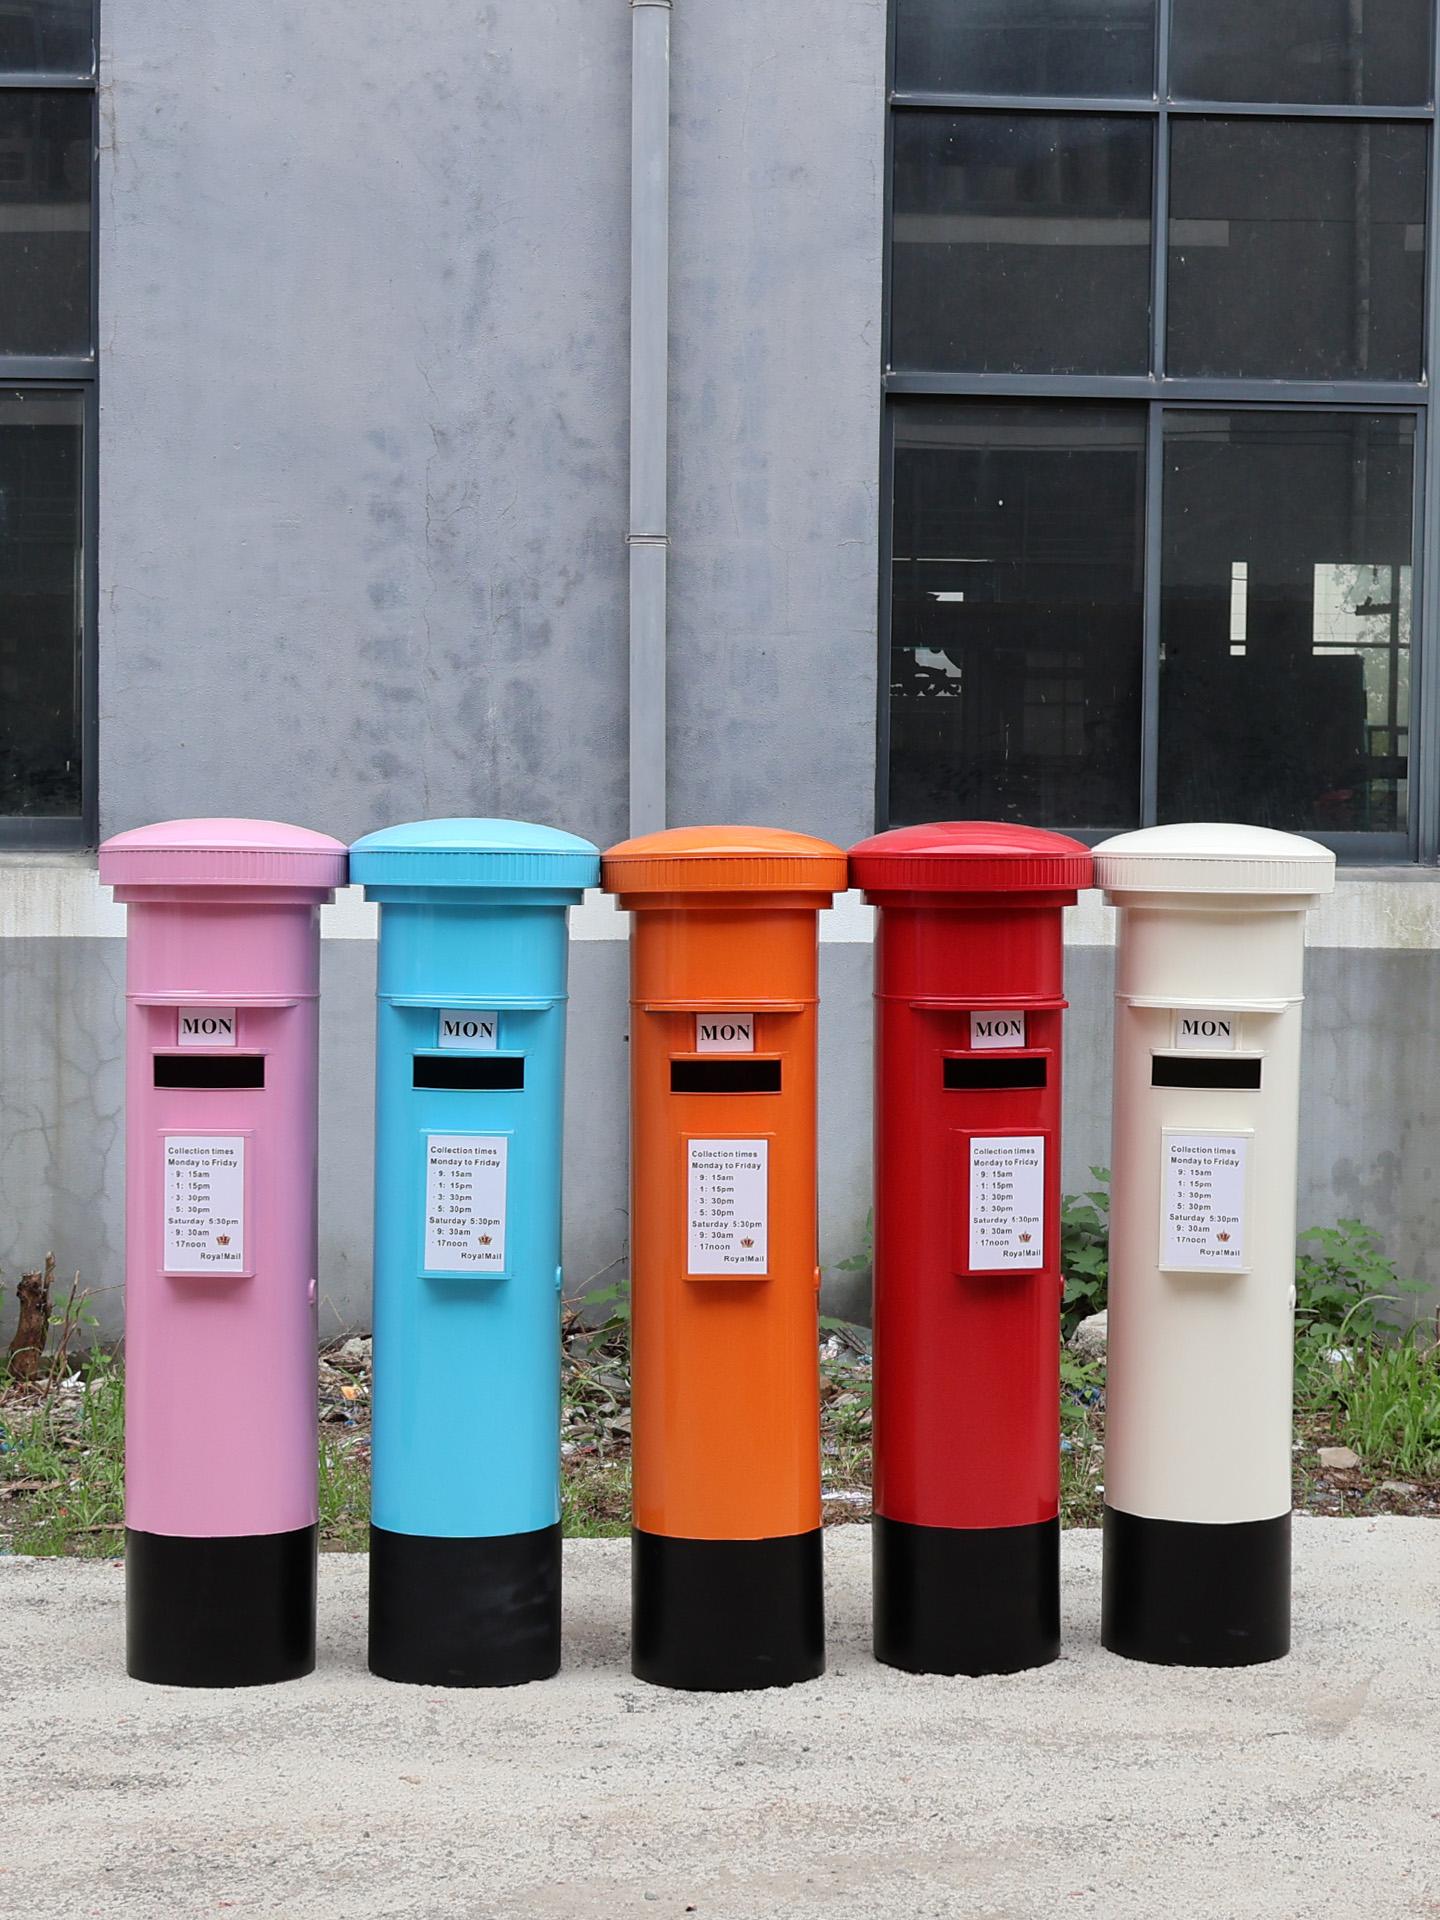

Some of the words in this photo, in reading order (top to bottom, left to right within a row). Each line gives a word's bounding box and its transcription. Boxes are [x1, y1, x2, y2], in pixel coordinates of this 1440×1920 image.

[182, 1018, 233, 1034] MON
[443, 1020, 494, 1038] MON
[975, 1020, 1021, 1037] MON
[1181, 1019, 1231, 1037] MON
[700, 1024, 750, 1041] MON
[168, 1147, 210, 1155] Collection
[211, 1147, 234, 1155] times
[430, 1146, 473, 1154] Collection
[474, 1147, 497, 1155] times
[691, 1150, 734, 1158] Collection
[735, 1150, 758, 1158] times
[1171, 1145, 1213, 1154] Collection
[1214, 1147, 1236, 1155] times
[168, 1158, 200, 1167] Monday
[211, 1159, 238, 1168] Friday
[430, 1158, 463, 1166] Monday
[474, 1159, 501, 1168] Friday
[973, 1159, 1003, 1168] Monday
[1014, 1158, 1039, 1167] Friday
[1170, 1156, 1202, 1166] Monday
[1213, 1158, 1240, 1167] Friday
[691, 1162, 724, 1170] Monday
[450, 1170, 473, 1178] 15am
[992, 1170, 1013, 1178] 15am
[188, 1182, 210, 1191] 15pm
[450, 1182, 473, 1190] 15pm
[992, 1182, 1014, 1190] 15pm
[1189, 1180, 1212, 1189] 15pm
[711, 1186, 735, 1194] 15pm
[187, 1194, 210, 1202] 30pm
[449, 1194, 473, 1202] 30pm
[1189, 1192, 1212, 1200] 30pm
[711, 1197, 735, 1205] 30pm
[187, 1206, 210, 1214] 30pm
[449, 1206, 472, 1214] 30pm
[991, 1205, 1013, 1213] 30pm
[1188, 1203, 1211, 1211] 30pm
[711, 1209, 735, 1217] 30pm
[168, 1217, 205, 1226] Saturday
[429, 1216, 467, 1226] Saturday
[973, 1216, 1008, 1224] Saturday
[1169, 1213, 1205, 1223] Saturday
[692, 1221, 729, 1229] Saturday
[1188, 1225, 1210, 1233] 30am
[449, 1228, 471, 1236] 30am
[991, 1227, 1013, 1235] 30am
